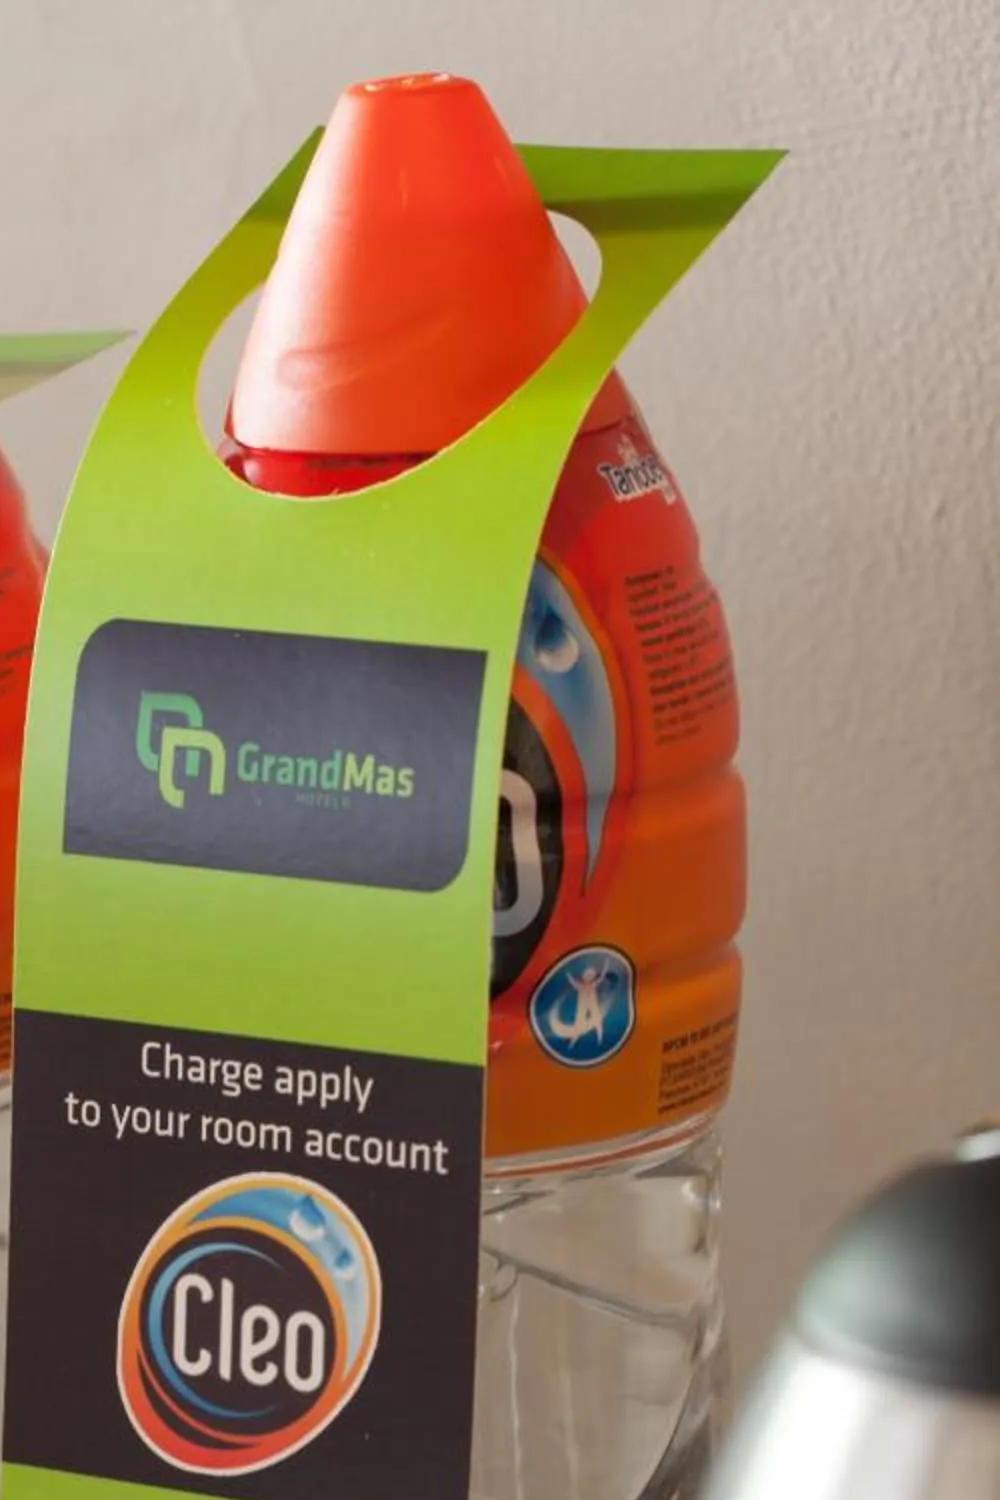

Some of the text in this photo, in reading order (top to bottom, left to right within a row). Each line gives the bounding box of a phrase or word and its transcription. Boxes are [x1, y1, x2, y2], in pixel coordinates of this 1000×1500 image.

[236, 741, 415, 798] GrandMas
[140, 1041, 374, 1114] Charge apply
[64, 1091, 449, 1175] to your room account
[172, 1273, 326, 1393] Cleo
